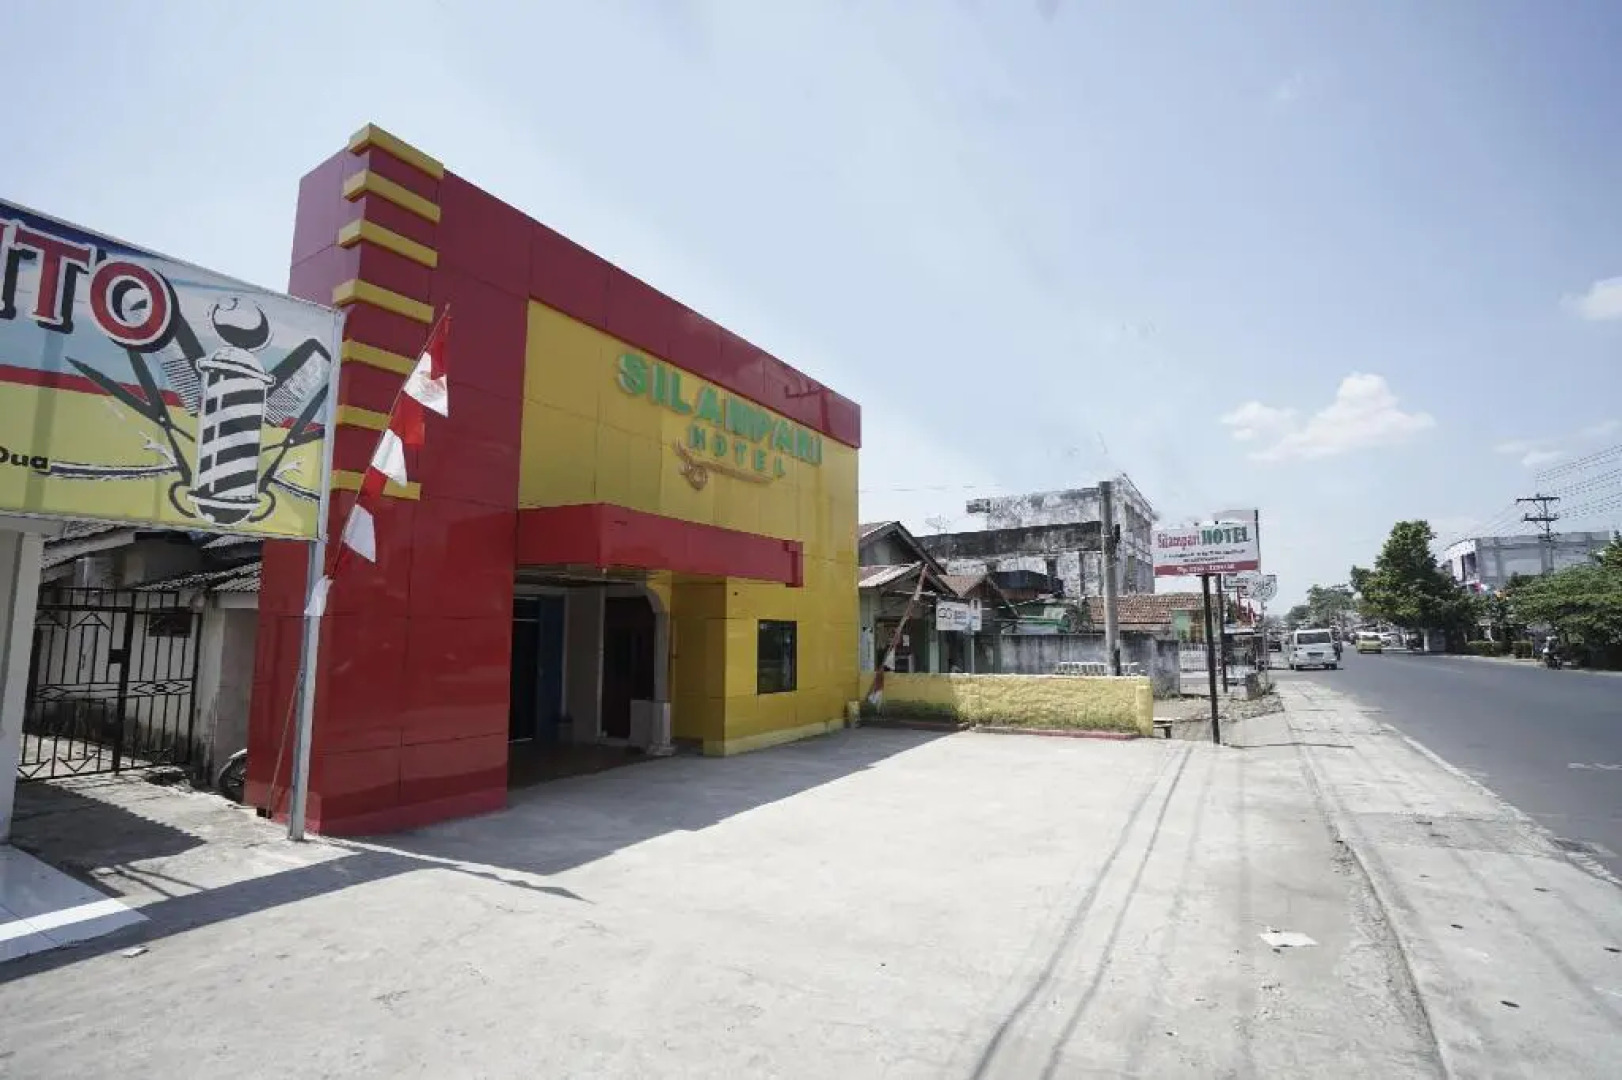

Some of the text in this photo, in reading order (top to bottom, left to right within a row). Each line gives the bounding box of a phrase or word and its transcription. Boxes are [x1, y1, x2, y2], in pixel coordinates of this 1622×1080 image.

[0, 219, 179, 352] TO
[687, 421, 786, 479] HOTEL
[1201, 526, 1249, 546] HOTEL
